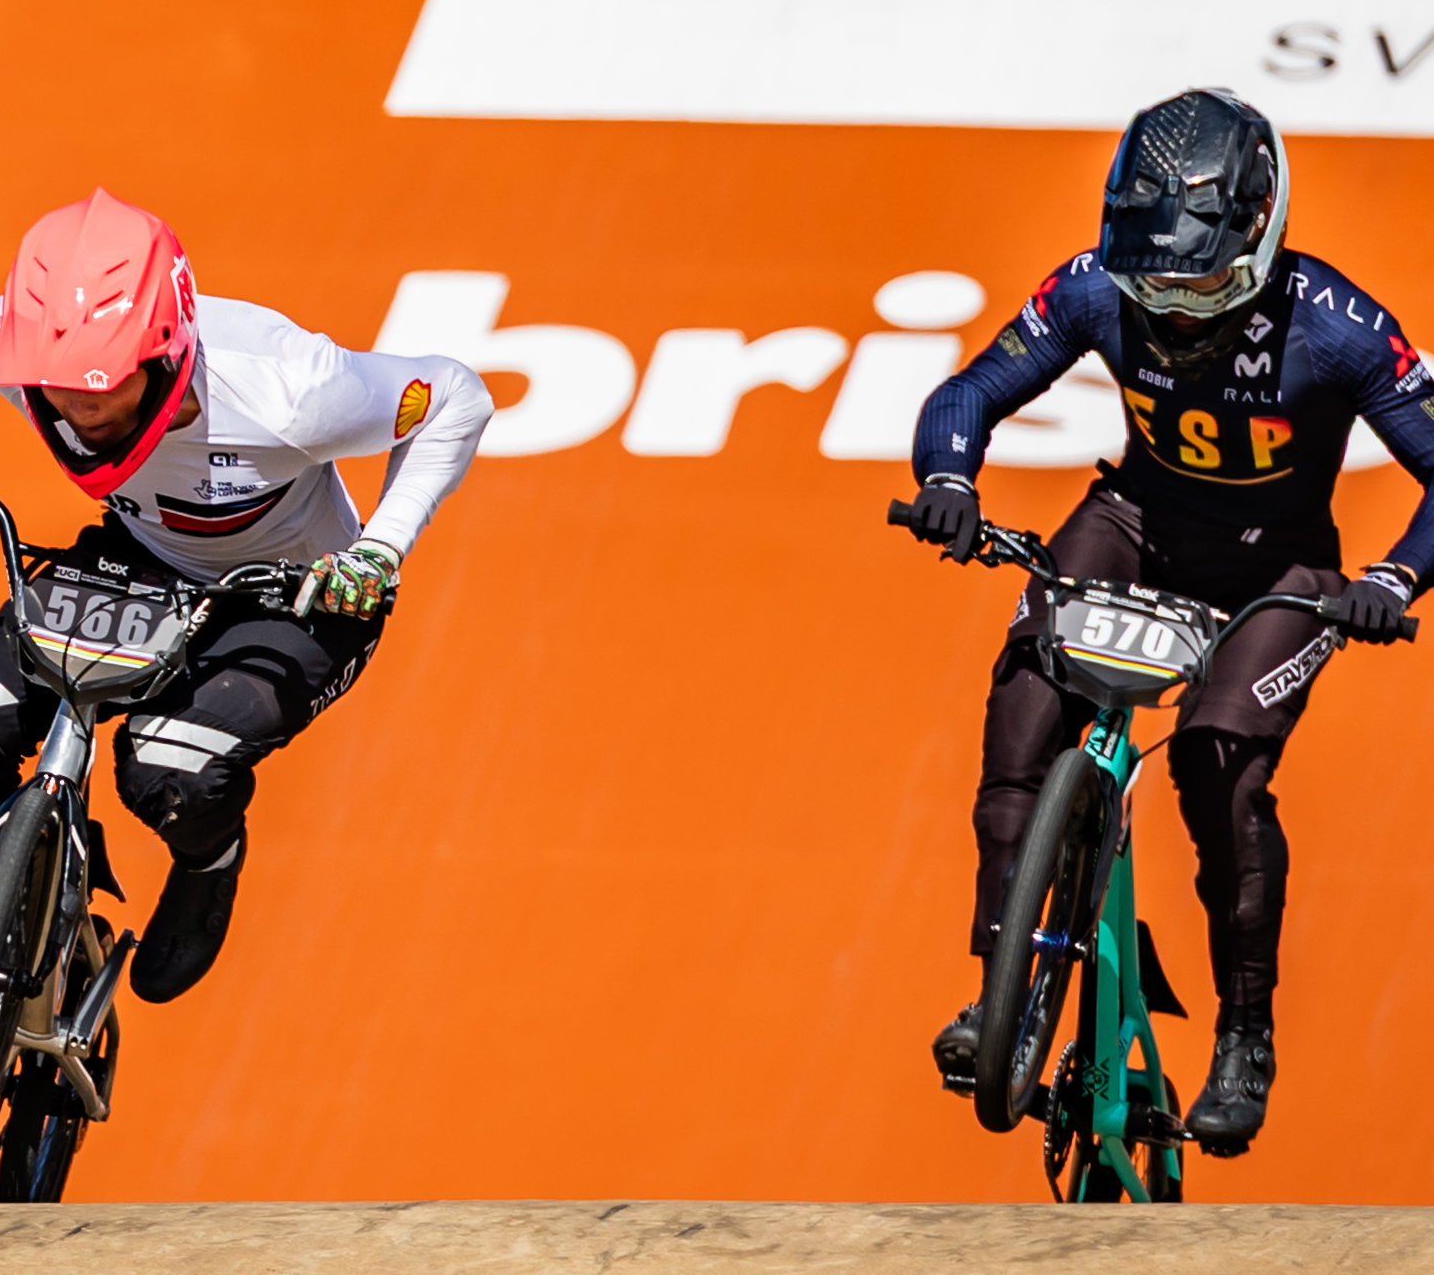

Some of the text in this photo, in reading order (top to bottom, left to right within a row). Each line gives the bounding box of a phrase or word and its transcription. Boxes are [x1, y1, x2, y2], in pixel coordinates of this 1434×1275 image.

[1285, 272, 1386, 331] RALI
[1138, 367, 1176, 391] GOBIK
[1224, 386, 1282, 404] RALI
[1123, 386, 1294, 469] ESP
[59, 568, 79, 579] UCI
[98, 556, 130, 577] box
[1128, 582, 1160, 603] box
[44, 585, 152, 649] 566
[1080, 605, 1177, 661] 570
